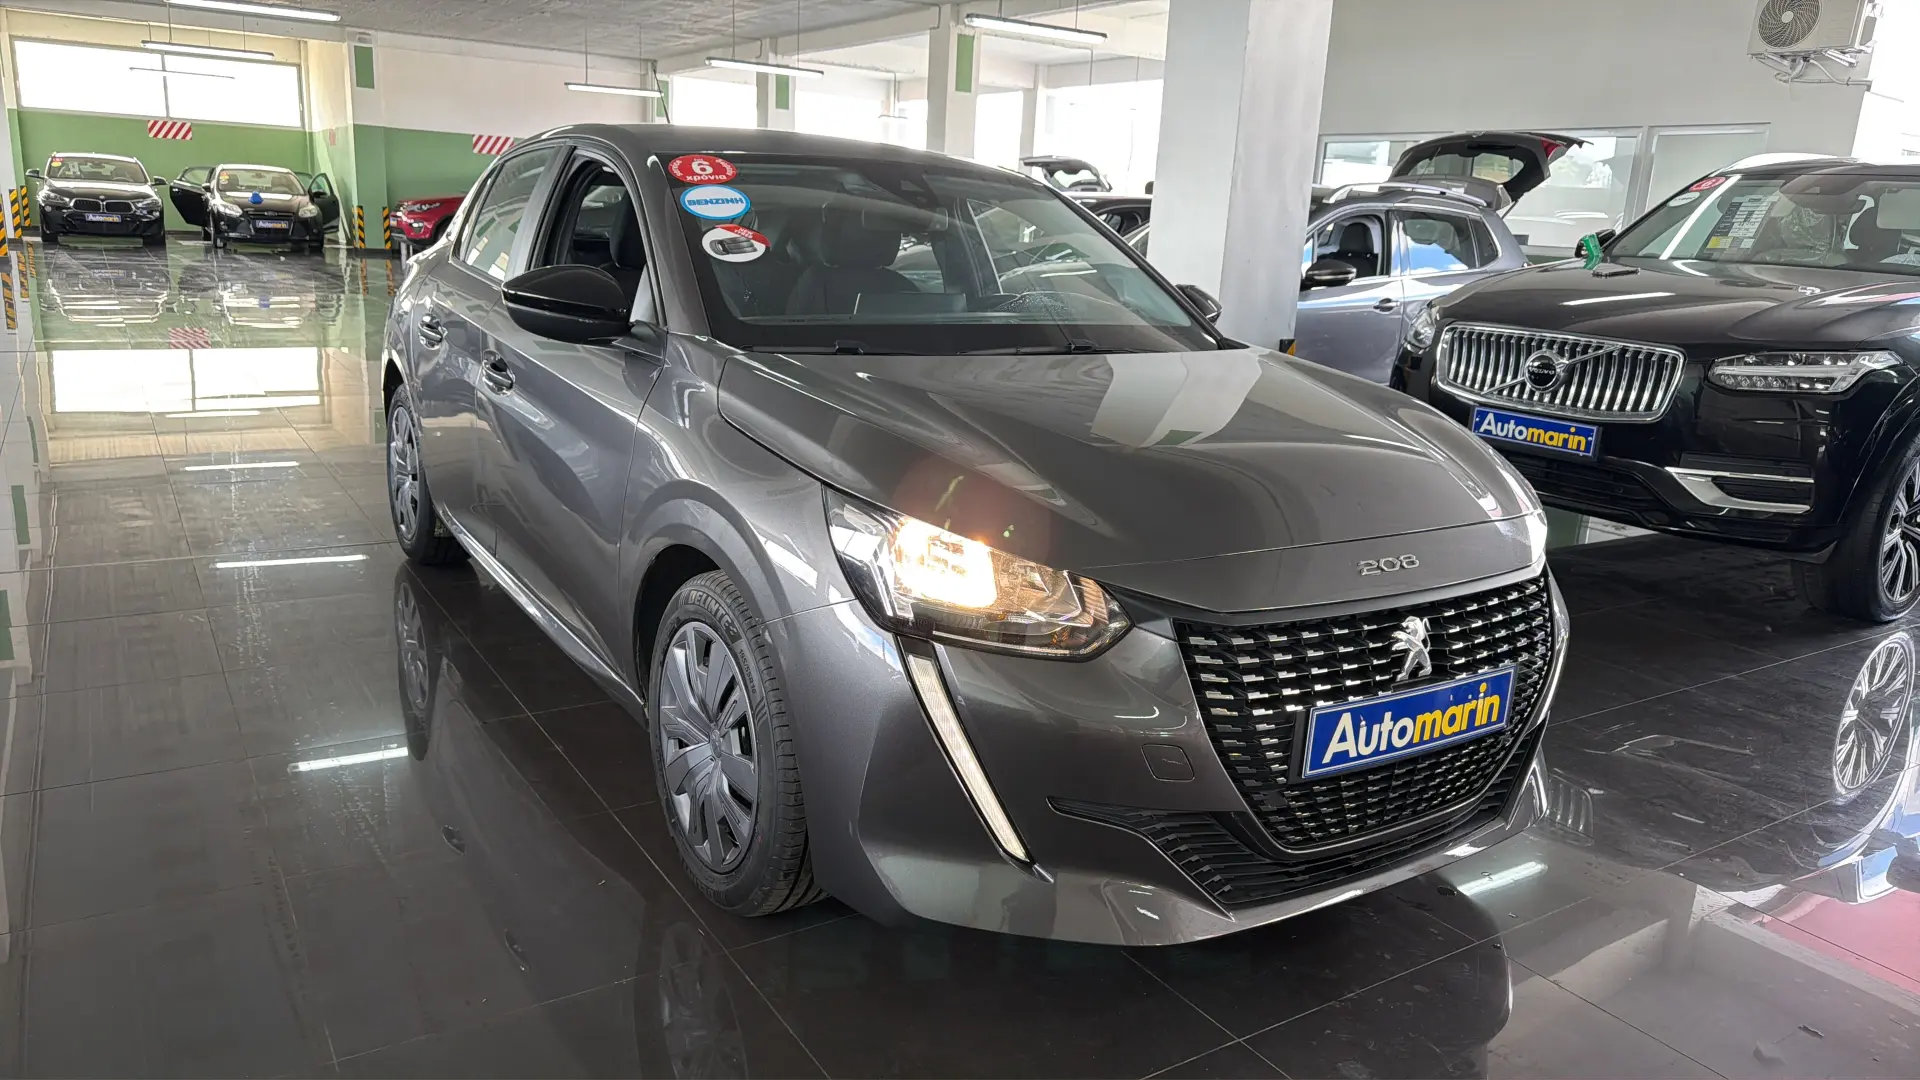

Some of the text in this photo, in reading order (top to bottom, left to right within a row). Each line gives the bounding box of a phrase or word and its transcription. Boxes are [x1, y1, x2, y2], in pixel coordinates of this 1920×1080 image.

[691, 161, 714, 174] 6
[1528, 366, 1555, 375] VOLVO
[1479, 412, 1586, 451] Automarin
[1357, 553, 1420, 576] 208
[1321, 682, 1501, 764] Automarin
